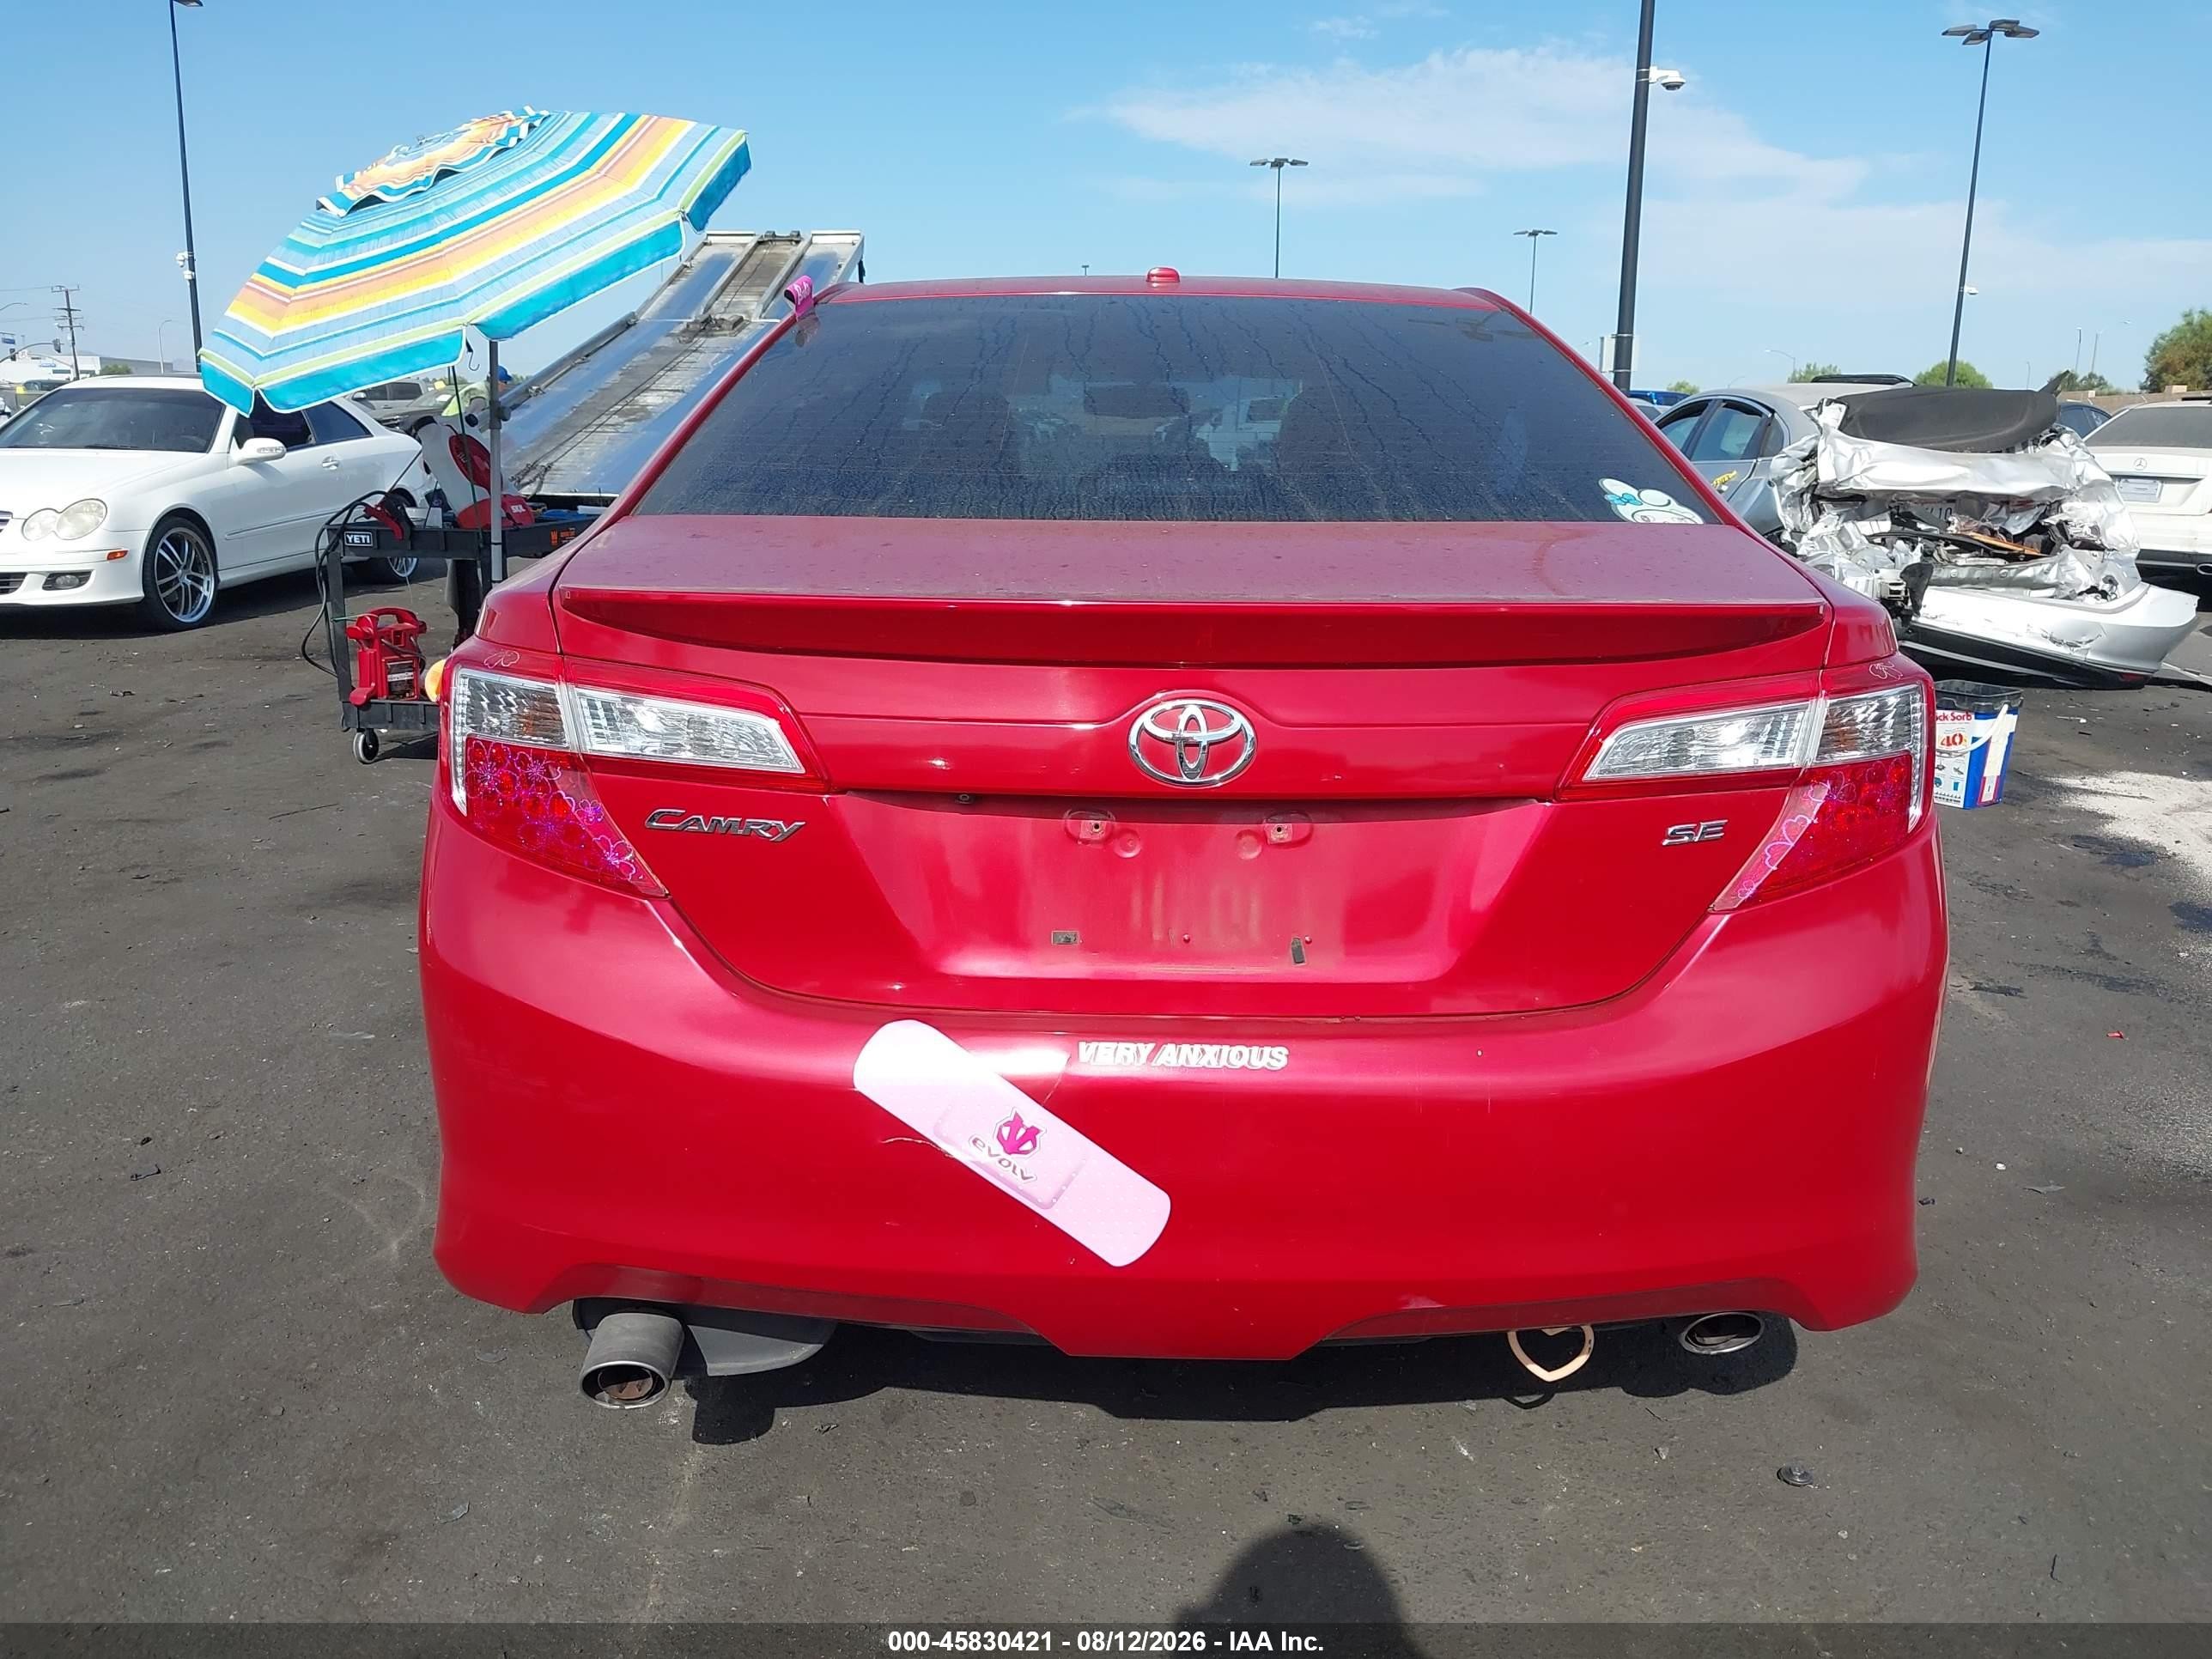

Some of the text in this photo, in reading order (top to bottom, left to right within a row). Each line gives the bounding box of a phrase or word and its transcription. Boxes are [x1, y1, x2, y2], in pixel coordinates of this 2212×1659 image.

[346, 533, 370, 544] YETI
[1940, 732, 1964, 747] 40
[646, 808, 806, 842] CAMRY
[1662, 819, 1729, 846] SE
[1078, 1042, 1289, 1070] VERY ANXIOUS
